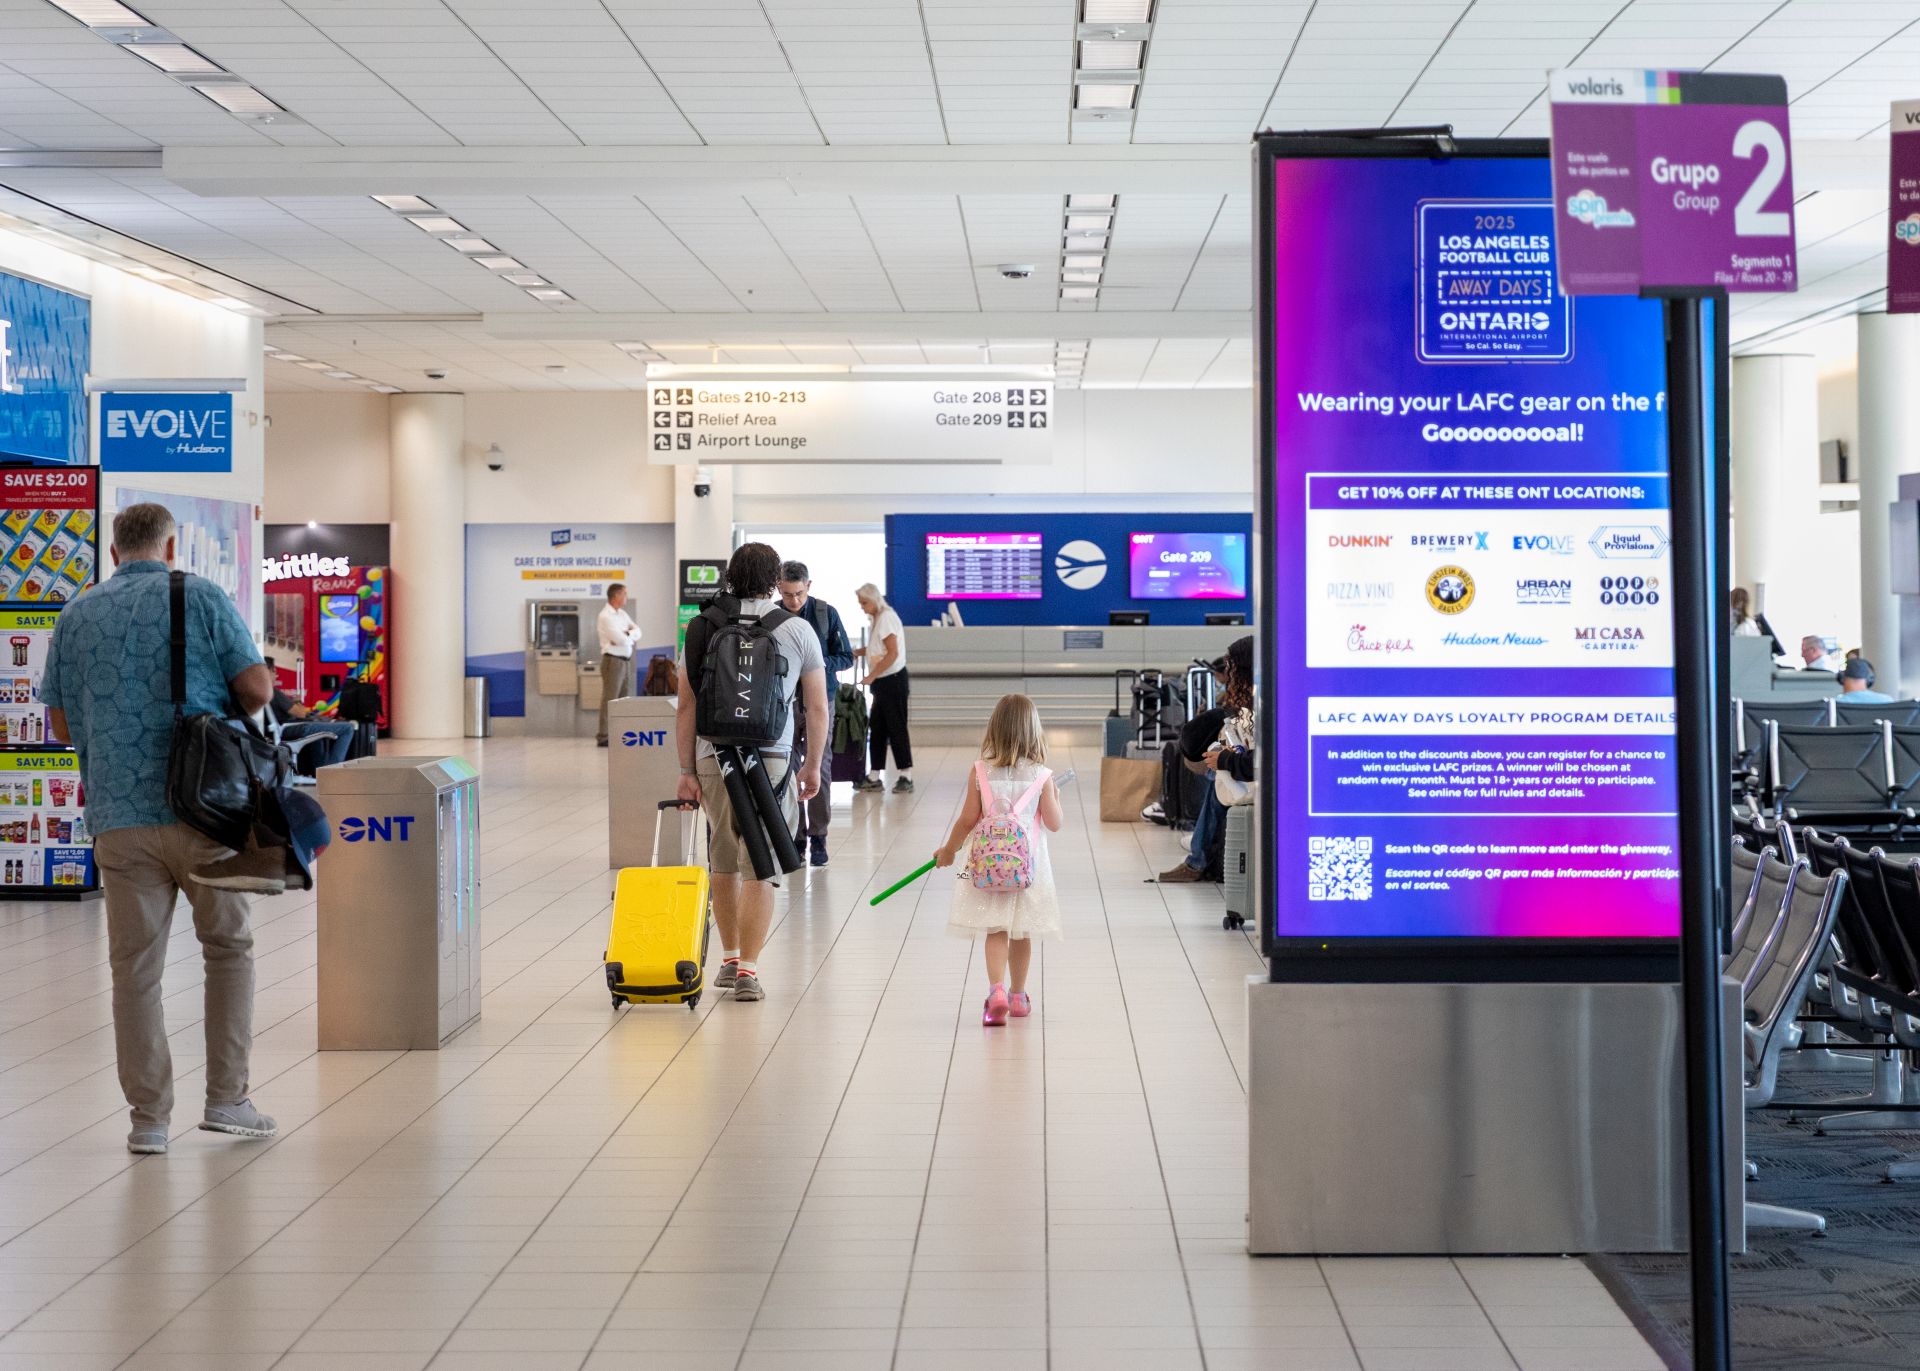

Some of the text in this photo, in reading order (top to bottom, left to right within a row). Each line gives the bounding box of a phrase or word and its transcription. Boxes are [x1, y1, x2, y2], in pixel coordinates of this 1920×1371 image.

[1568, 76, 1624, 95] volaris
[1651, 157, 1720, 190] Grupo
[1732, 120, 1790, 236] 2
[1673, 191, 1720, 215] Group
[1475, 216, 1515, 230] 2025
[1440, 236, 1550, 249] LOS ANGELES
[1440, 252, 1550, 264] FOOTBALL CLUB
[1731, 254, 1782, 271] Segmento
[1449, 279, 1542, 296] AWAY DAYS
[698, 391, 806, 404] Gates 210-213
[933, 391, 1002, 404] Gate 208
[1298, 391, 1650, 416] Wearing your LAFC gear on the
[107, 409, 226, 439] EVOLVE
[698, 413, 777, 426] Relief Area
[935, 412, 1002, 426] Gate 209
[1422, 423, 1584, 442] Gooooooooal!
[176, 442, 225, 454] Hudson
[697, 434, 807, 450] Airport Lounge
[4, 472, 88, 488] SAVE $2.00
[1338, 486, 1645, 499] GET 10% OFF AT THESE ONT LOCATIONS:
[574, 533, 597, 541] HEALTH
[1329, 535, 1393, 548] DUNKIN'
[1411, 531, 1489, 551] BREWERY X
[1513, 535, 1575, 551] EVOLVE
[1613, 534, 1641, 544] Liquid
[1604, 542, 1655, 550] Provisions
[514, 557, 632, 566] CARE FOR YOUR WHOLE FAMILY
[1160, 551, 1212, 563] Gate 209
[1516, 580, 1571, 588] URBAN
[1600, 576, 1644, 590] TAP
[1328, 583, 1361, 600] PIZZA
[1516, 588, 1571, 598] CRAVE
[1600, 591, 1659, 605] POUR
[16, 616, 45, 626] SAVE
[1441, 633, 1549, 647] Hudson News
[1575, 627, 1645, 640] MI CASA
[735, 640, 754, 718] RAZER
[1318, 713, 1357, 723] LAFC
[1362, 713, 1408, 723] AWAY
[1414, 713, 1454, 723] DAYS
[1459, 713, 1525, 723] LOYALTY
[1530, 713, 1608, 723] PROGRAM
[622, 731, 667, 746] ONT
[16, 757, 73, 767] SAVE $1.00
[1408, 788, 1585, 798] See online for full rules and details.
[339, 816, 415, 842] ONT
[1385, 844, 1672, 856] Scan the QR code to learn more and enter the giveaway.
[1385, 868, 1431, 878] Escanea
[1433, 868, 1444, 878] el
[1446, 868, 1482, 880] código
[1484, 868, 1501, 880] QR
[1503, 870, 1529, 880] para
[1531, 868, 1554, 878] más
[1557, 868, 1622, 878] información
[1624, 870, 1632, 880] y
[1385, 881, 1450, 890] en el sorteo.
